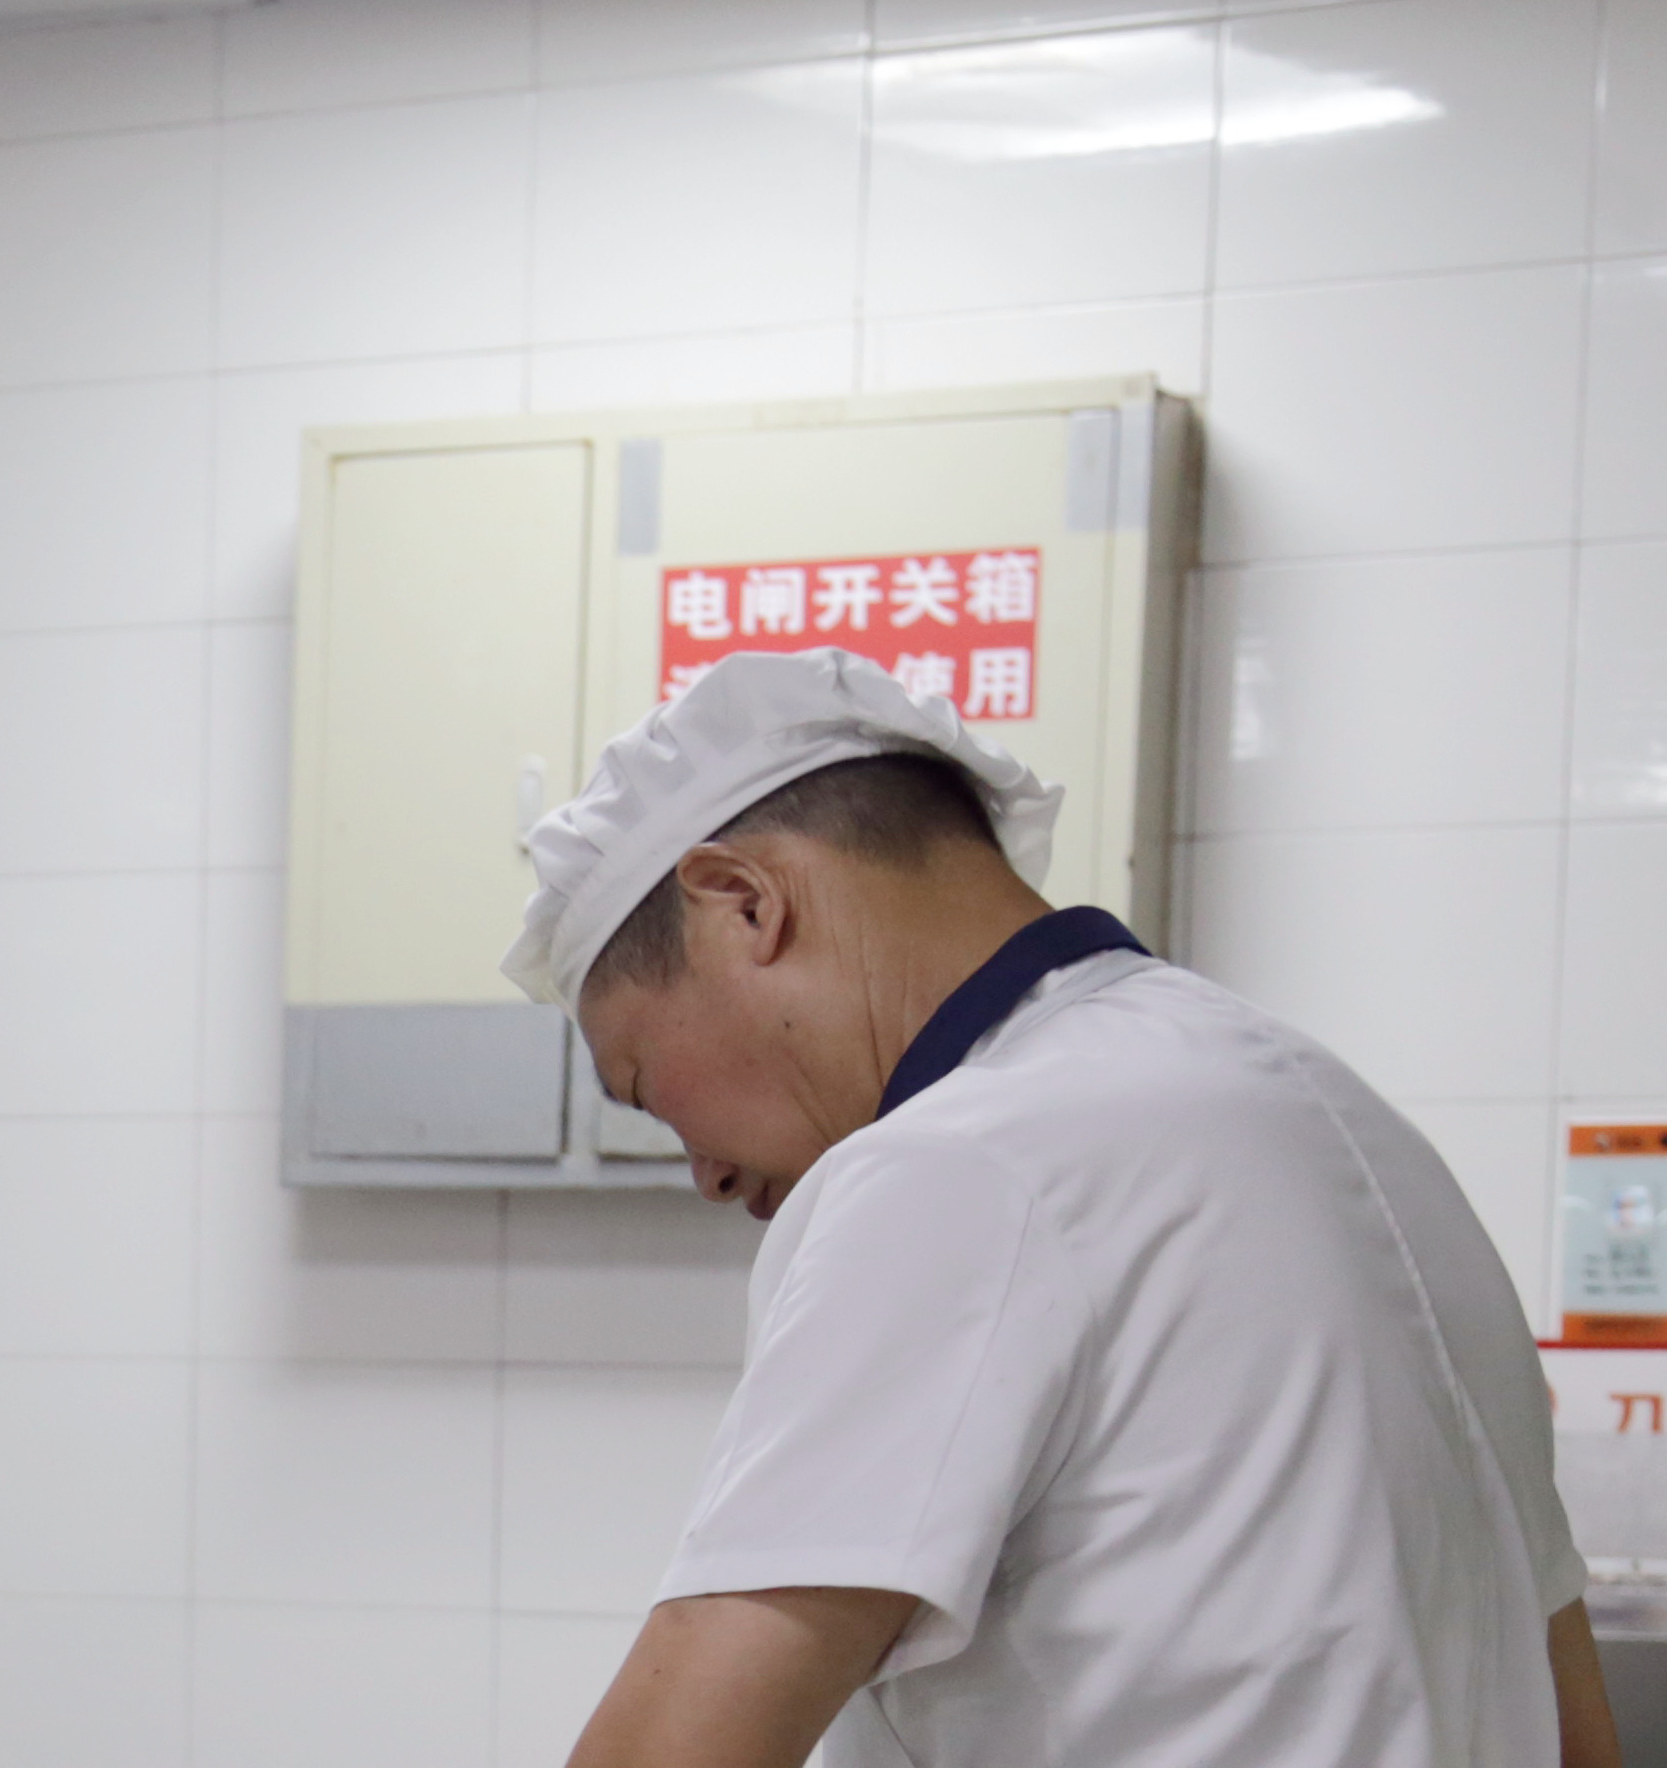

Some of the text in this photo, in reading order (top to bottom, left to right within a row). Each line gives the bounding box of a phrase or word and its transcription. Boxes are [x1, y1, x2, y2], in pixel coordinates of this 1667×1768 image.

[667, 552, 1037, 639] 电闸开关箱
